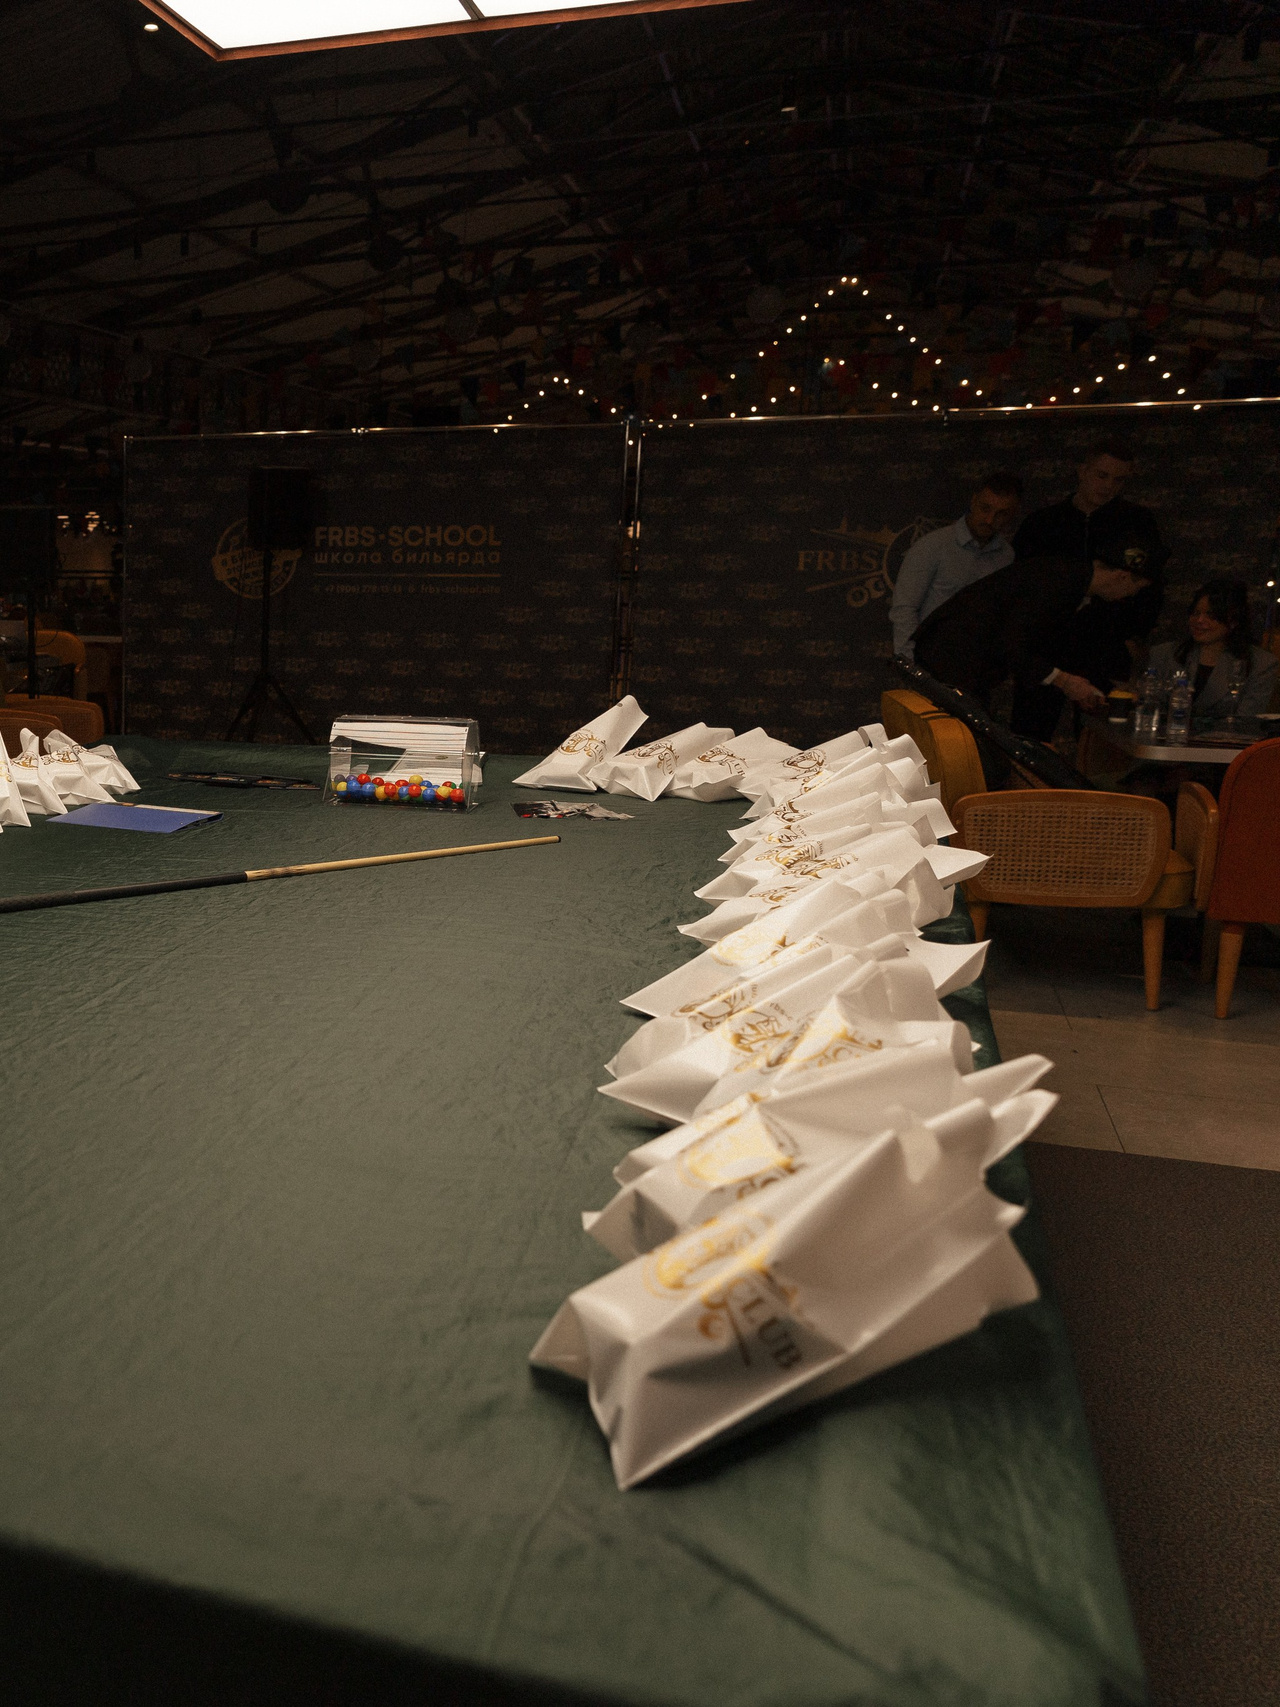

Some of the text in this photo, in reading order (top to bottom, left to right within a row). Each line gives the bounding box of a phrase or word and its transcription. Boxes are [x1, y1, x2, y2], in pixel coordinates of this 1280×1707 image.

[314, 547, 502, 567] школа бильярда
[798, 548, 880, 572] FRBS
[725, 1276, 805, 1370] CLUB
